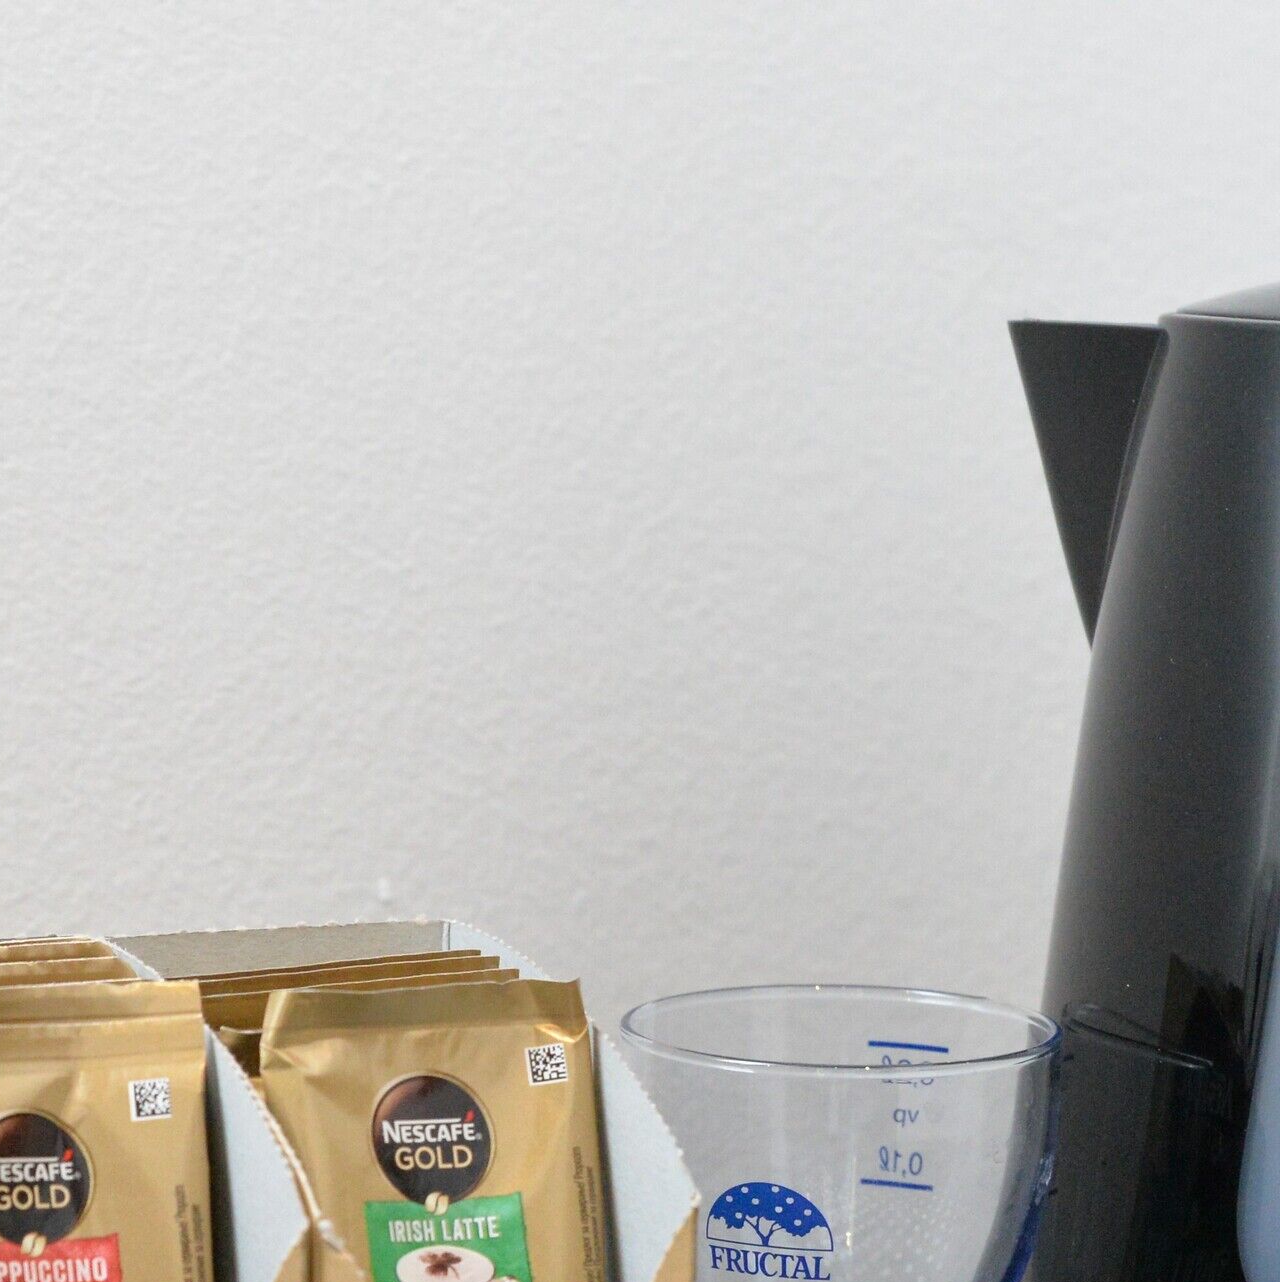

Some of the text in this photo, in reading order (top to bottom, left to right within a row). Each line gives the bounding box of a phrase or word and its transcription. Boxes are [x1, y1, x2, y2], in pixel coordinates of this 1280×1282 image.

[394, 1146, 473, 1170] GOLD
[388, 1215, 500, 1242] IRISH LATTE
[709, 1245, 831, 1280] FRUCTAL
